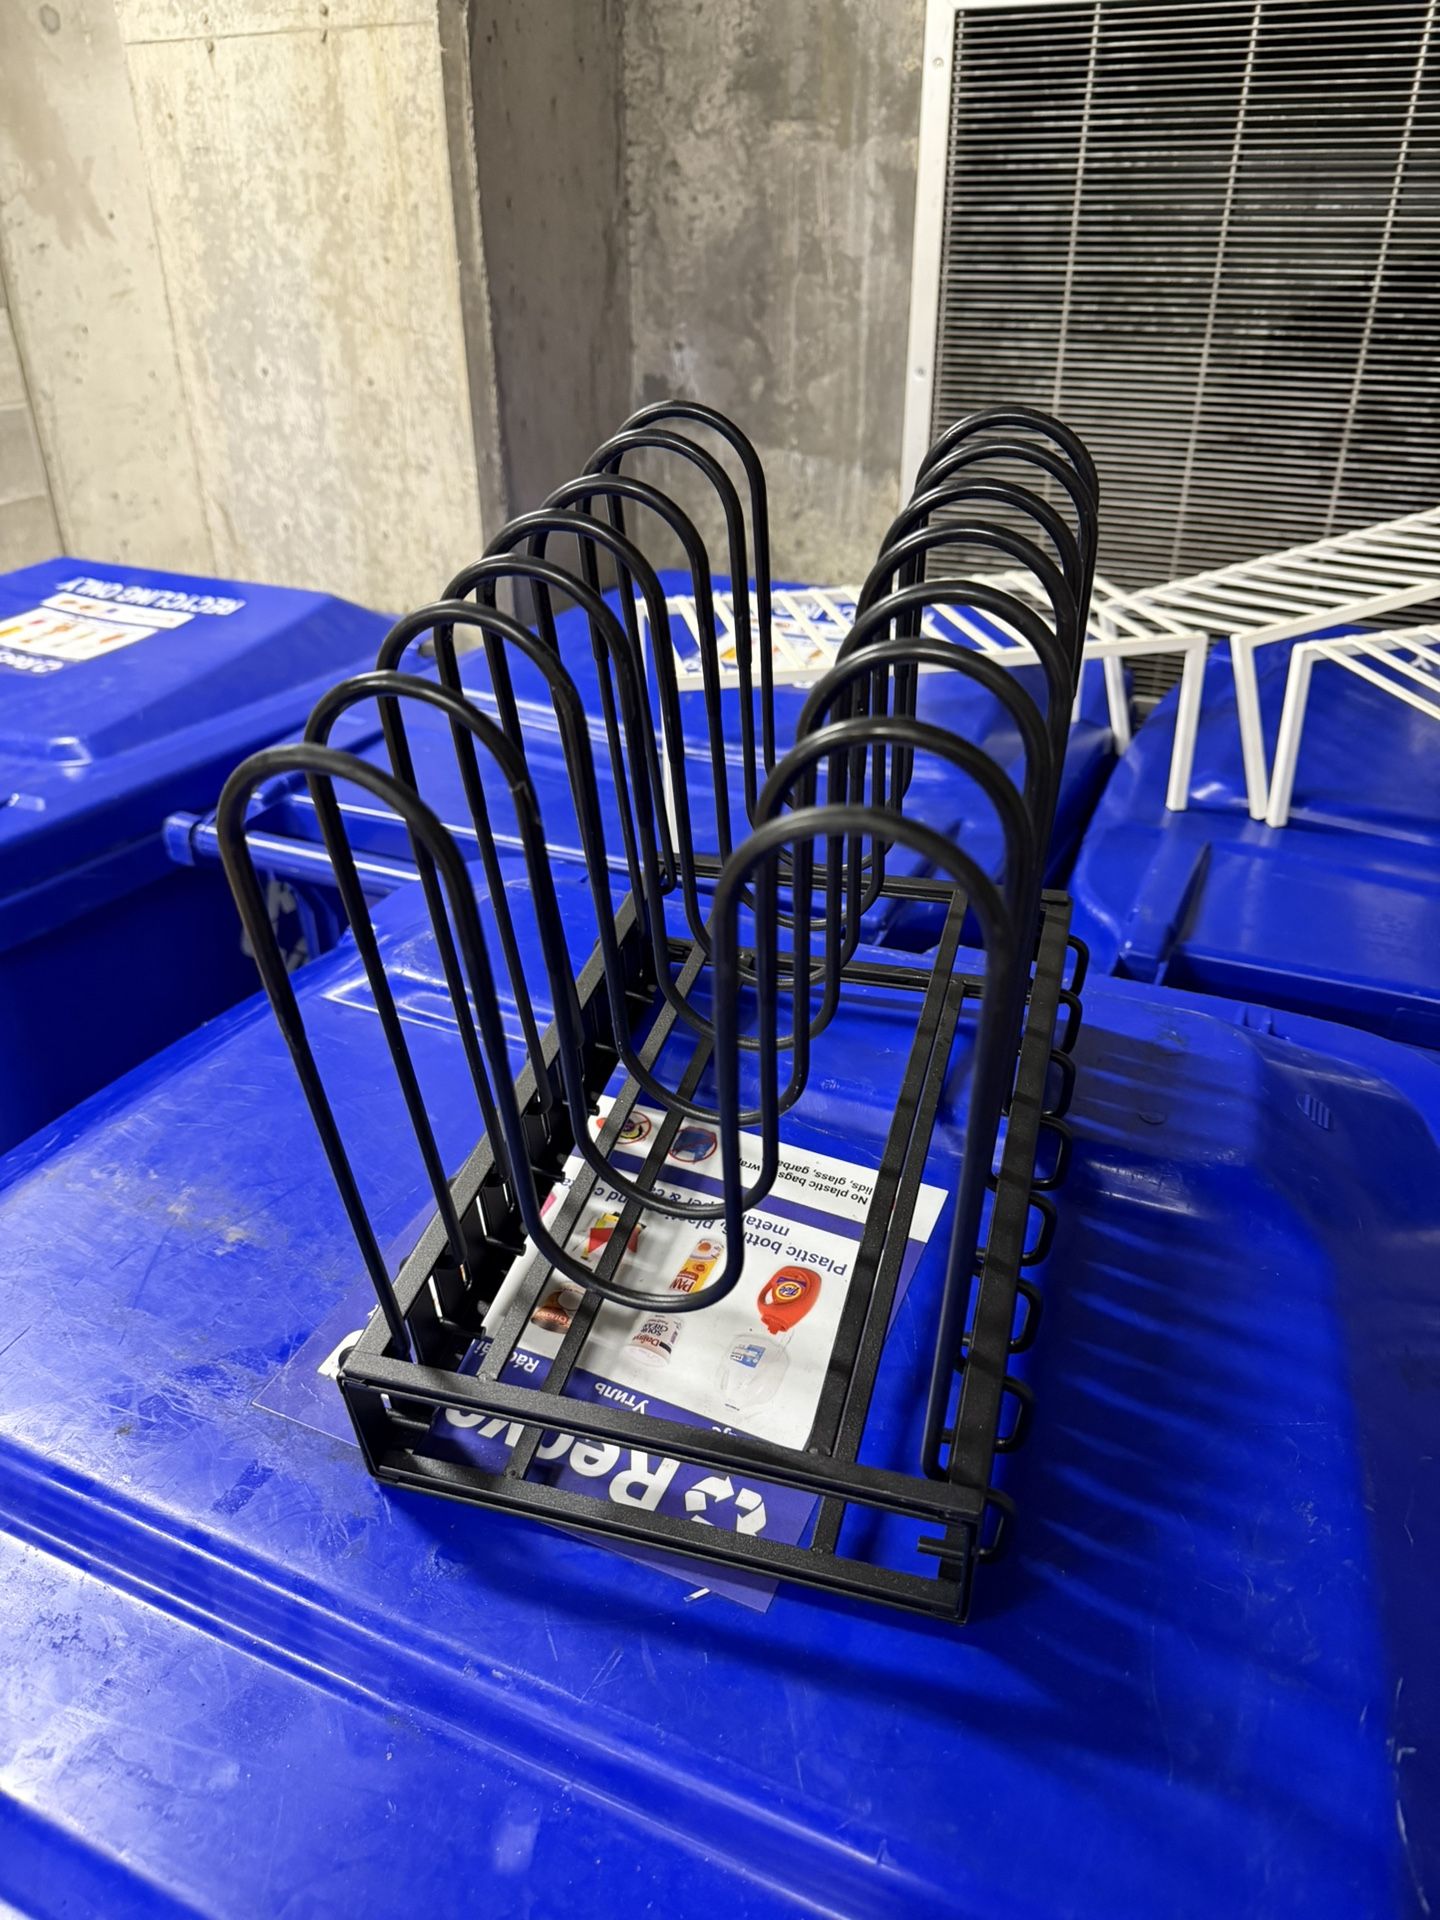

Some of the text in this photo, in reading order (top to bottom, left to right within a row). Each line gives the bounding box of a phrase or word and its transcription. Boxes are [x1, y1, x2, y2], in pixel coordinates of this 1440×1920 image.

[55, 576, 246, 616] RECYCLING ONLY
[813, 1169, 846, 1186] glass,
[808, 1180, 849, 1199] plastic
[849, 1181, 873, 1195] lids,
[850, 1193, 869, 1205] No
[786, 1245, 848, 1276] Plastic
[595, 1382, 649, 1414] Утиль
